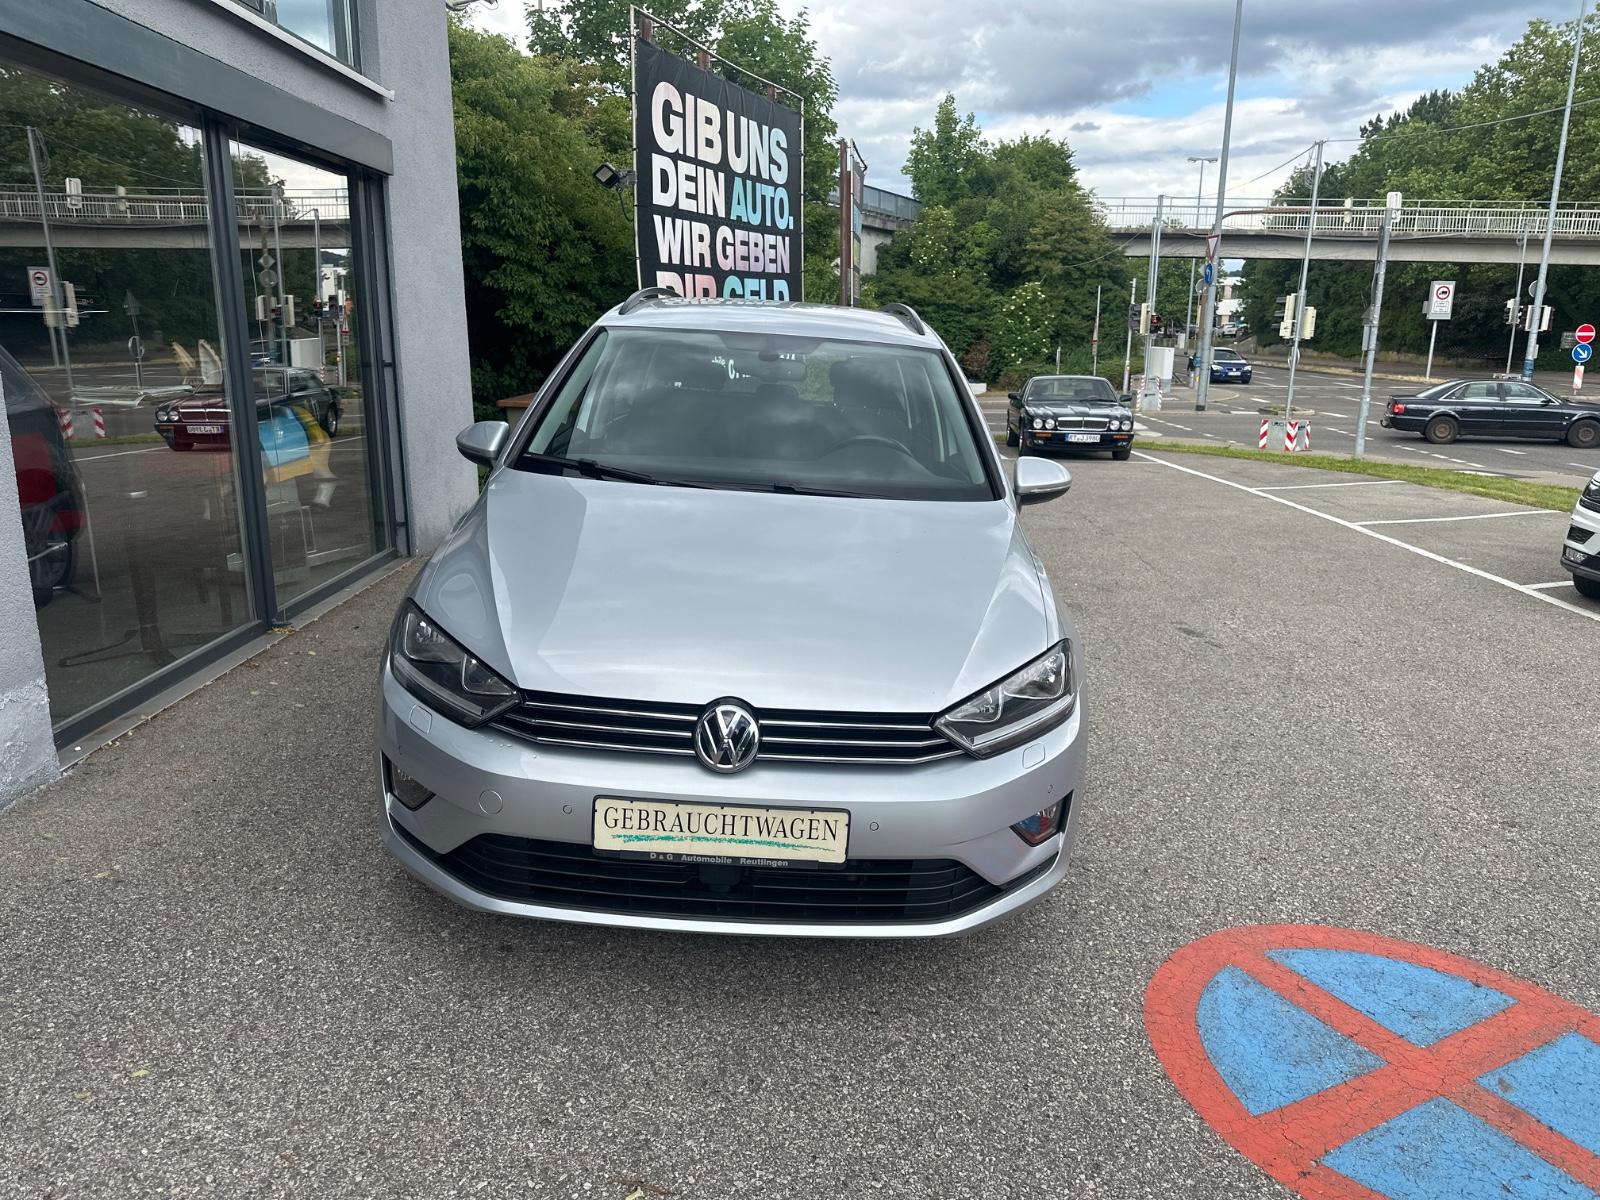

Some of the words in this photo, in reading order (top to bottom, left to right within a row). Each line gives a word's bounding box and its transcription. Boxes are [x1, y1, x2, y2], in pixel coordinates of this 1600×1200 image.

[651, 81, 722, 164] GIB
[727, 110, 789, 185] UNS
[651, 153, 725, 218] DEIN
[730, 177, 794, 230] AUTO.
[653, 214, 711, 268] WIR
[716, 225, 790, 274] GEBEN
[699, 705, 757, 771] VW
[603, 806, 838, 841] GEBRAUCHTWAGEN
[666, 853, 673, 861] G
[681, 854, 732, 864] Automobile
[740, 857, 789, 868] Reutlingen
